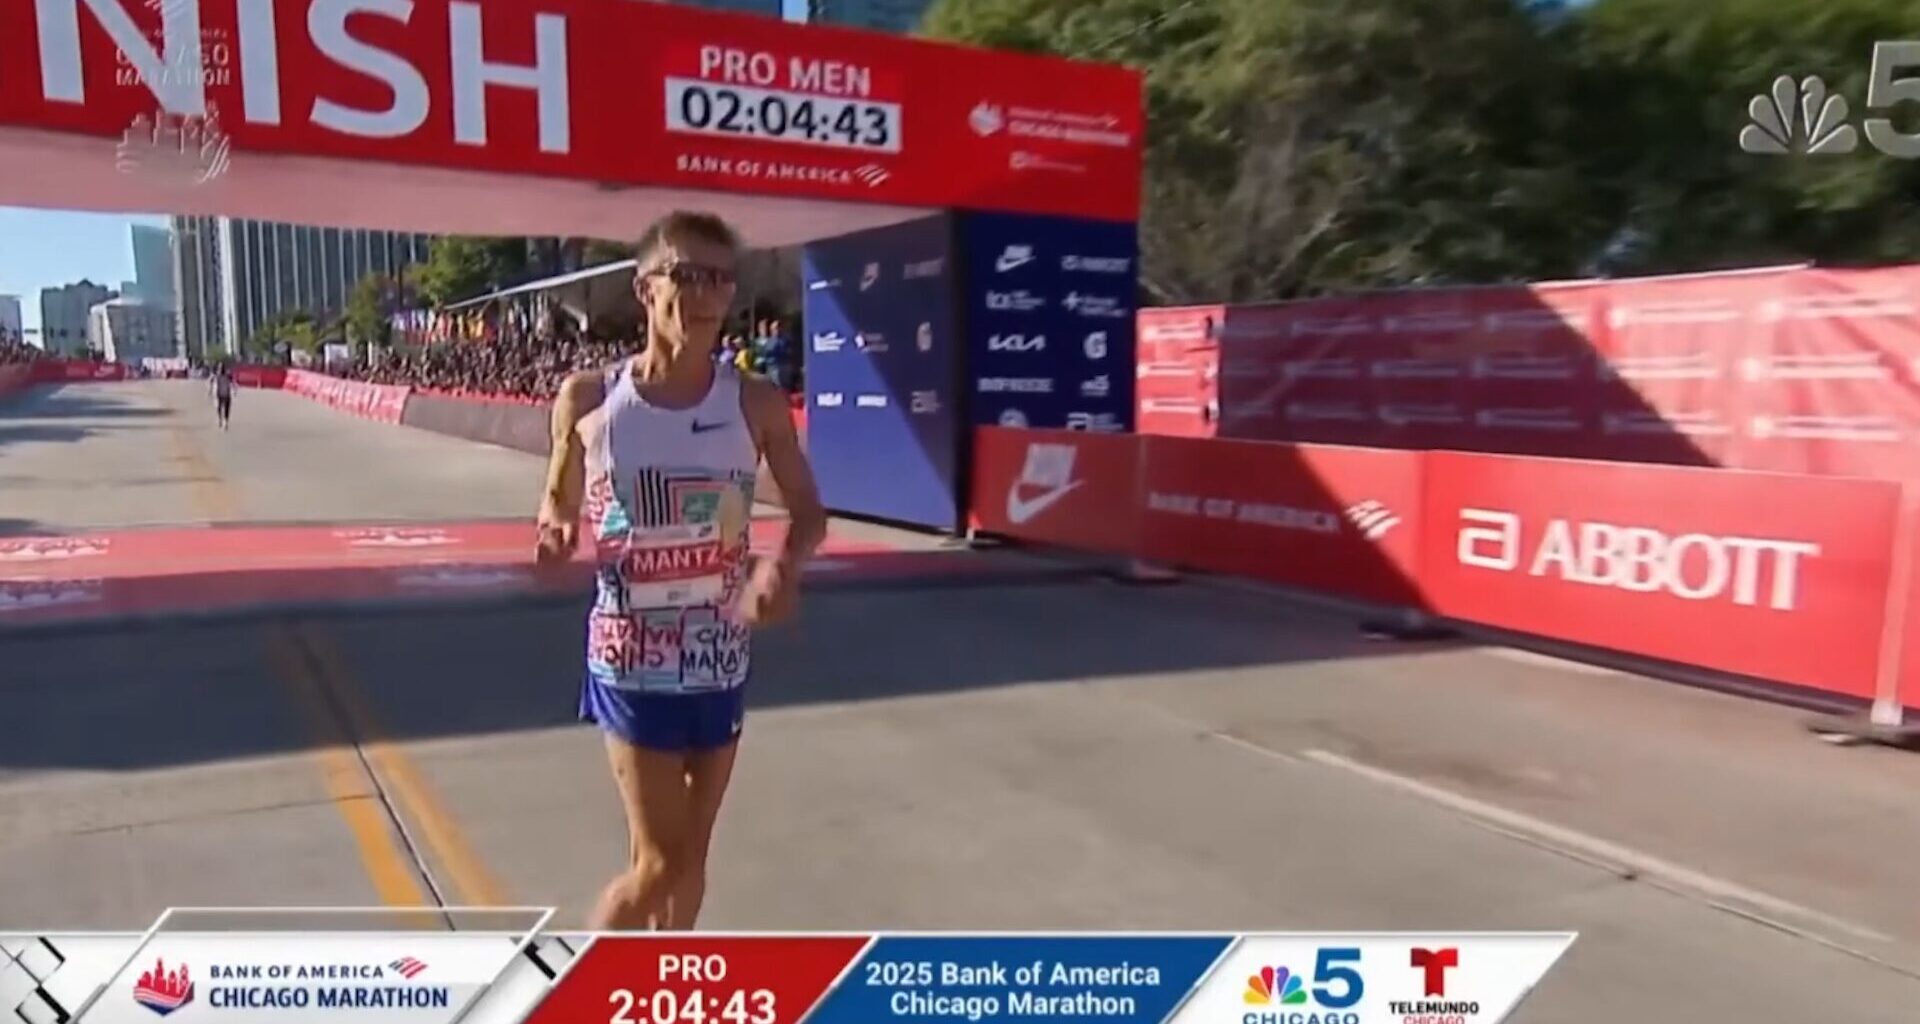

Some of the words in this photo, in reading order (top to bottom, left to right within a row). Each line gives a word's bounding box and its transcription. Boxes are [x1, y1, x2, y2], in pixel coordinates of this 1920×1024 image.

[700, 45, 777, 86] PRO
[789, 56, 870, 96] MEN
[681, 86, 888, 147] 02:04:43
[676, 154, 732, 174] BANK
[735, 159, 760, 177] OF
[766, 161, 853, 183] AMERICA
[632, 546, 720, 574] MANTZ
[1529, 518, 1822, 610] ABBOTT
